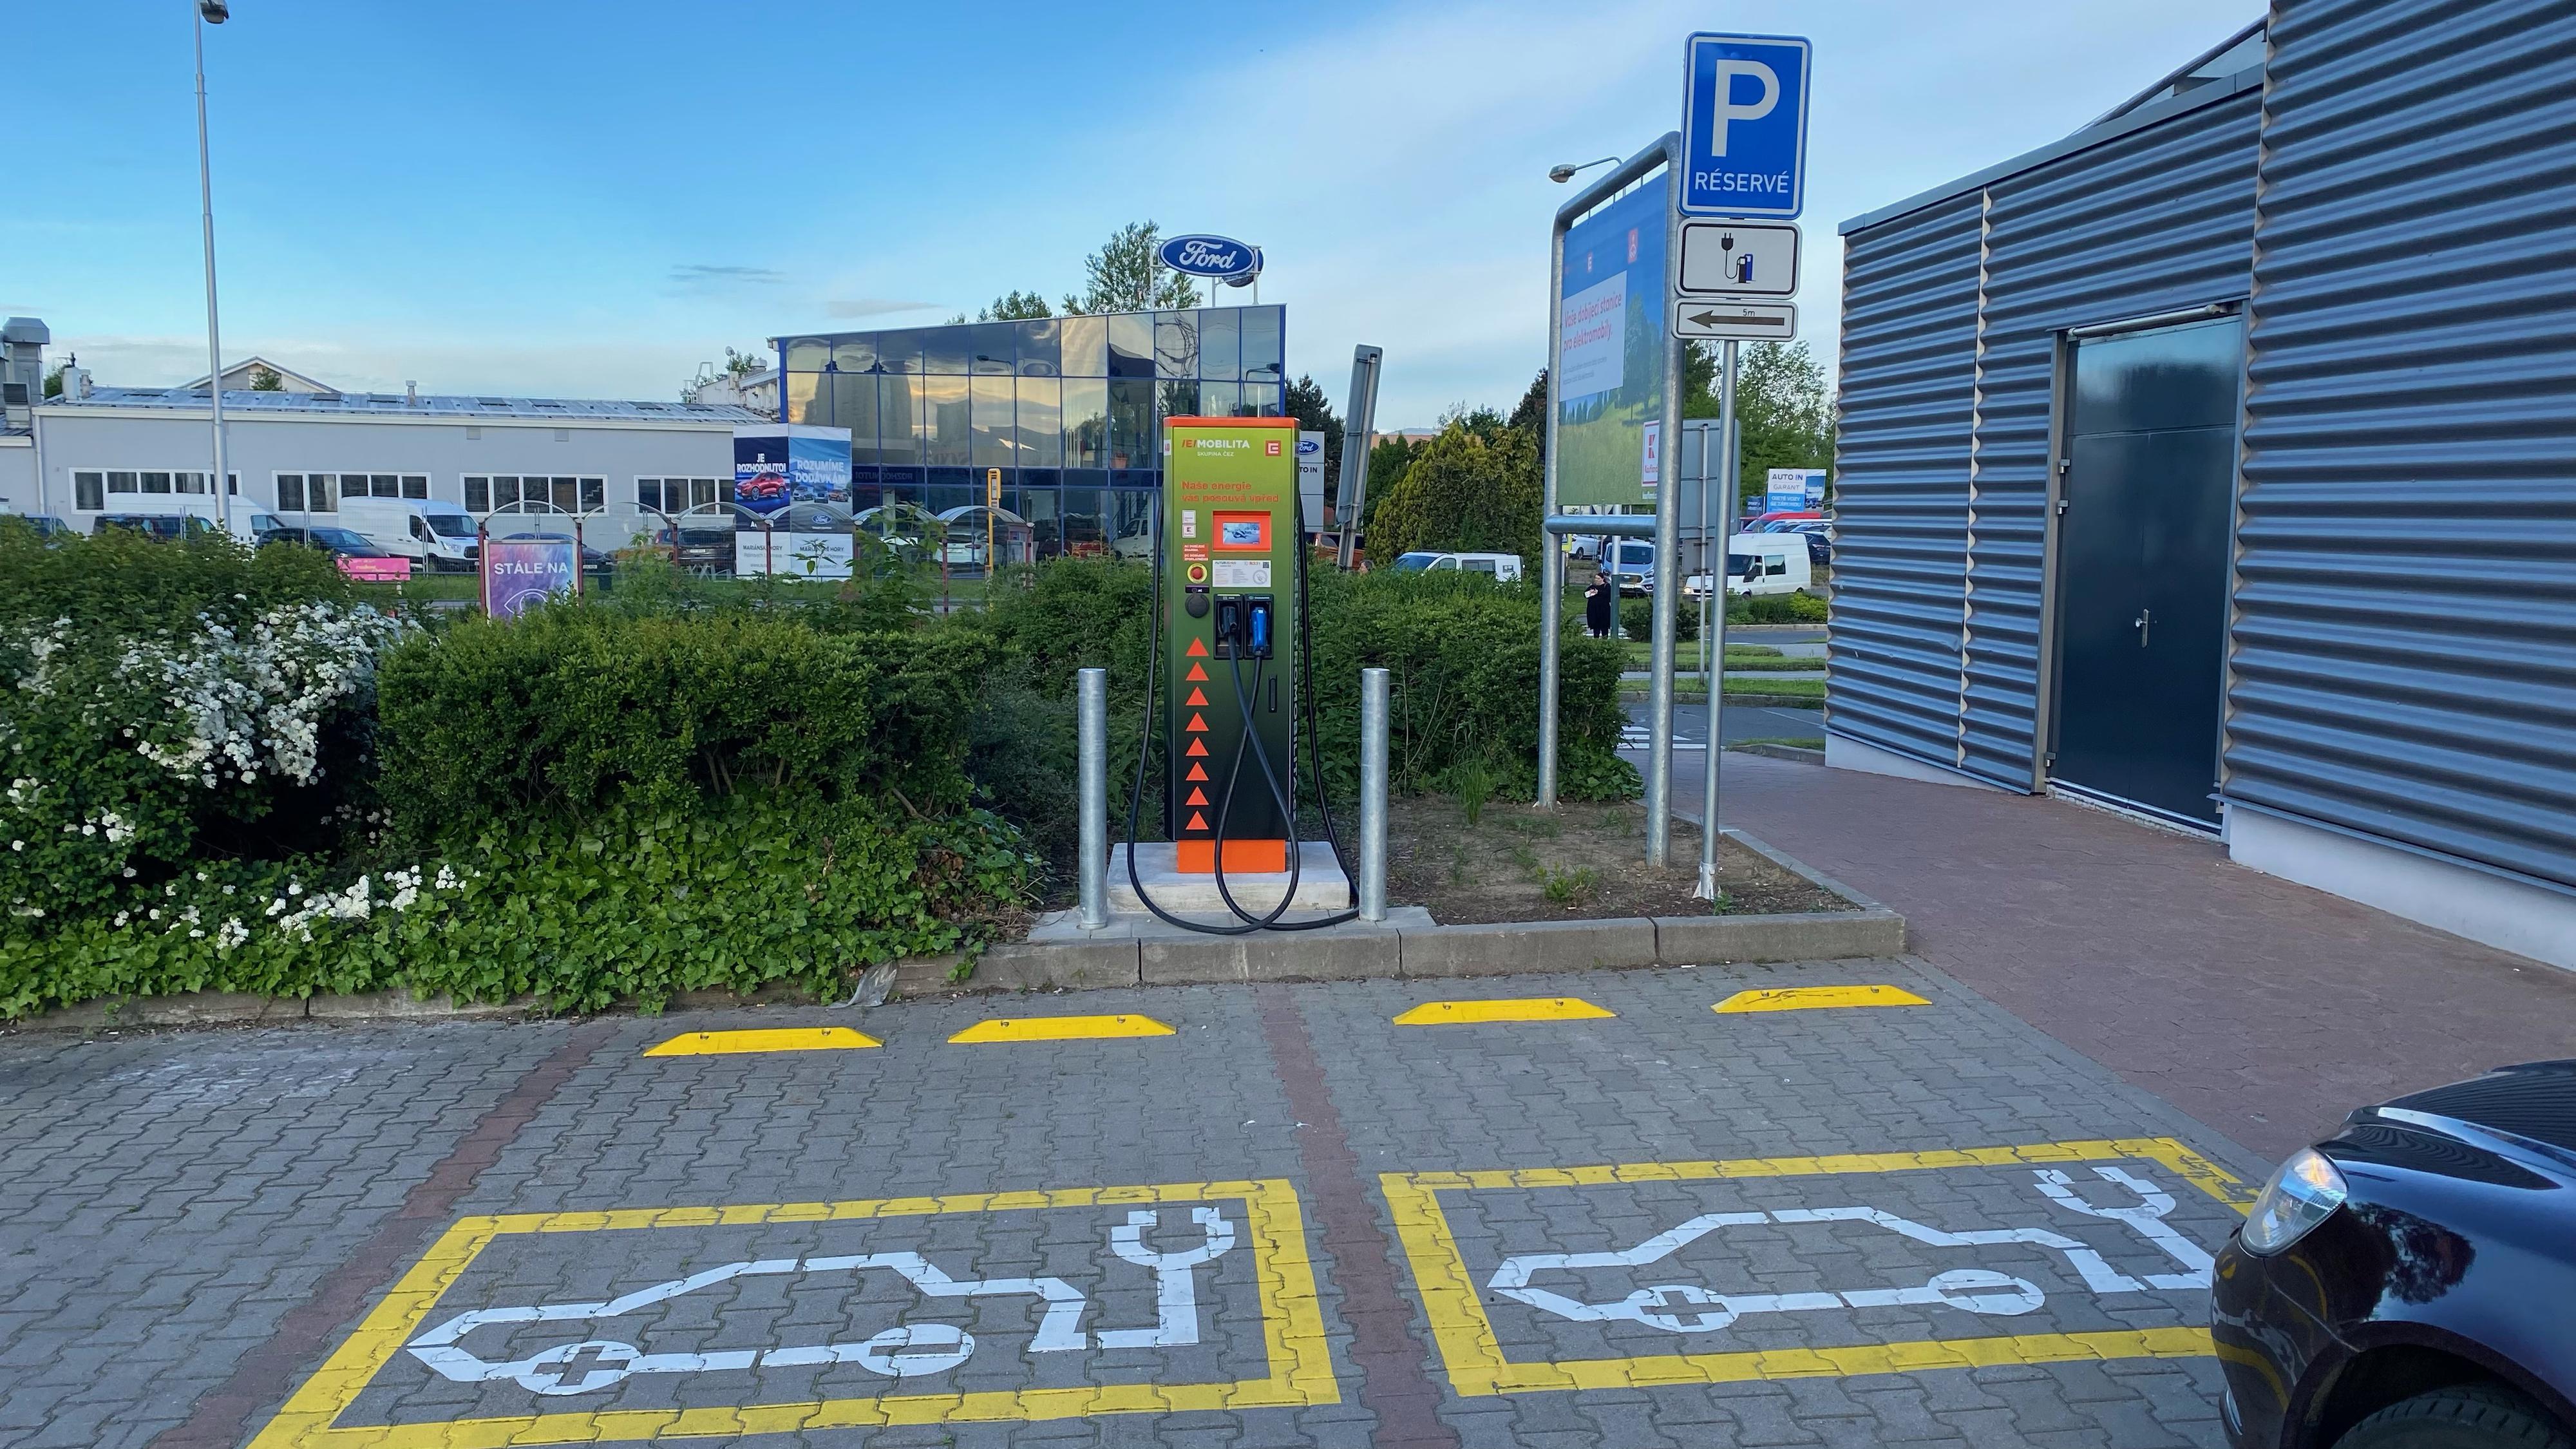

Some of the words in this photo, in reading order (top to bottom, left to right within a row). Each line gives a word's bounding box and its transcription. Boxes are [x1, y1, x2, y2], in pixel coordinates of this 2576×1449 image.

[1711, 59, 1780, 157] P
[1694, 168, 1790, 193] RÉSERVÉ
[1179, 240, 1237, 269] Ford
[1600, 292, 1622, 314] stanice
[1742, 308, 1756, 317] 5m
[1563, 339, 1572, 355] pro
[757, 453, 765, 462] JE
[797, 459, 844, 472] ROZUMÍME
[1211, 481, 1252, 491] energie
[494, 559, 544, 575] STÁLE
[547, 562, 568, 574] NA
